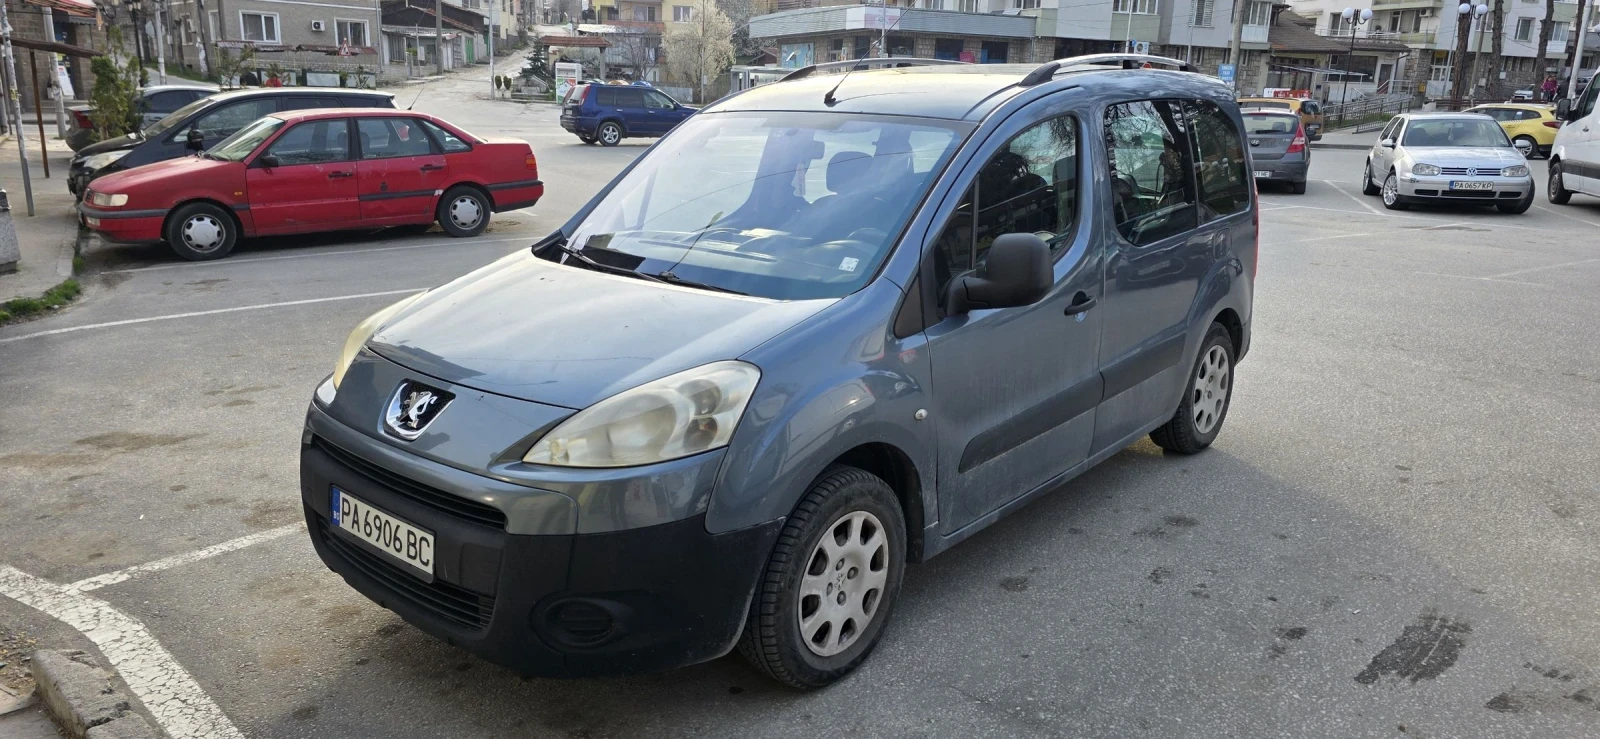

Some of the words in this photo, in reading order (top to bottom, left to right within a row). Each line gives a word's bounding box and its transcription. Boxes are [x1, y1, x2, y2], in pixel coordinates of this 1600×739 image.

[341, 497, 360, 533] PA
[364, 509, 403, 554] 6906
[407, 529, 430, 567] BC
